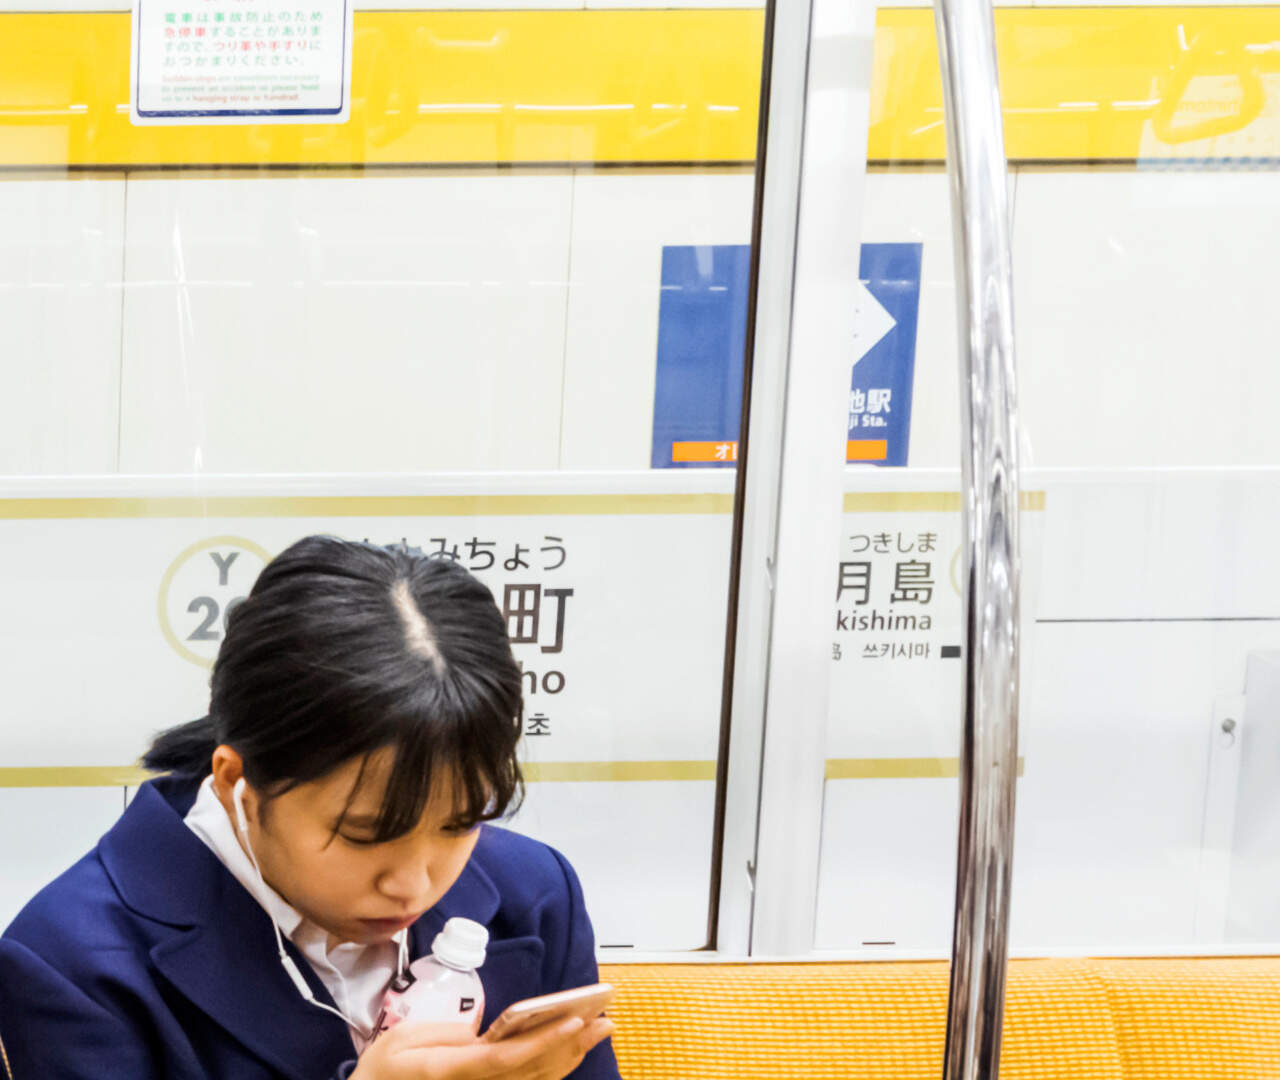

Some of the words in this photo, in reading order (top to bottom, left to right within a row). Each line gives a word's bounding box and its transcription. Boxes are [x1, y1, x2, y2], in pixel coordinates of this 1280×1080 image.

[862, 414, 887, 427] Sta.
[849, 532, 937, 554] つきしま
[208, 551, 240, 586] Y
[836, 559, 935, 605] 月島
